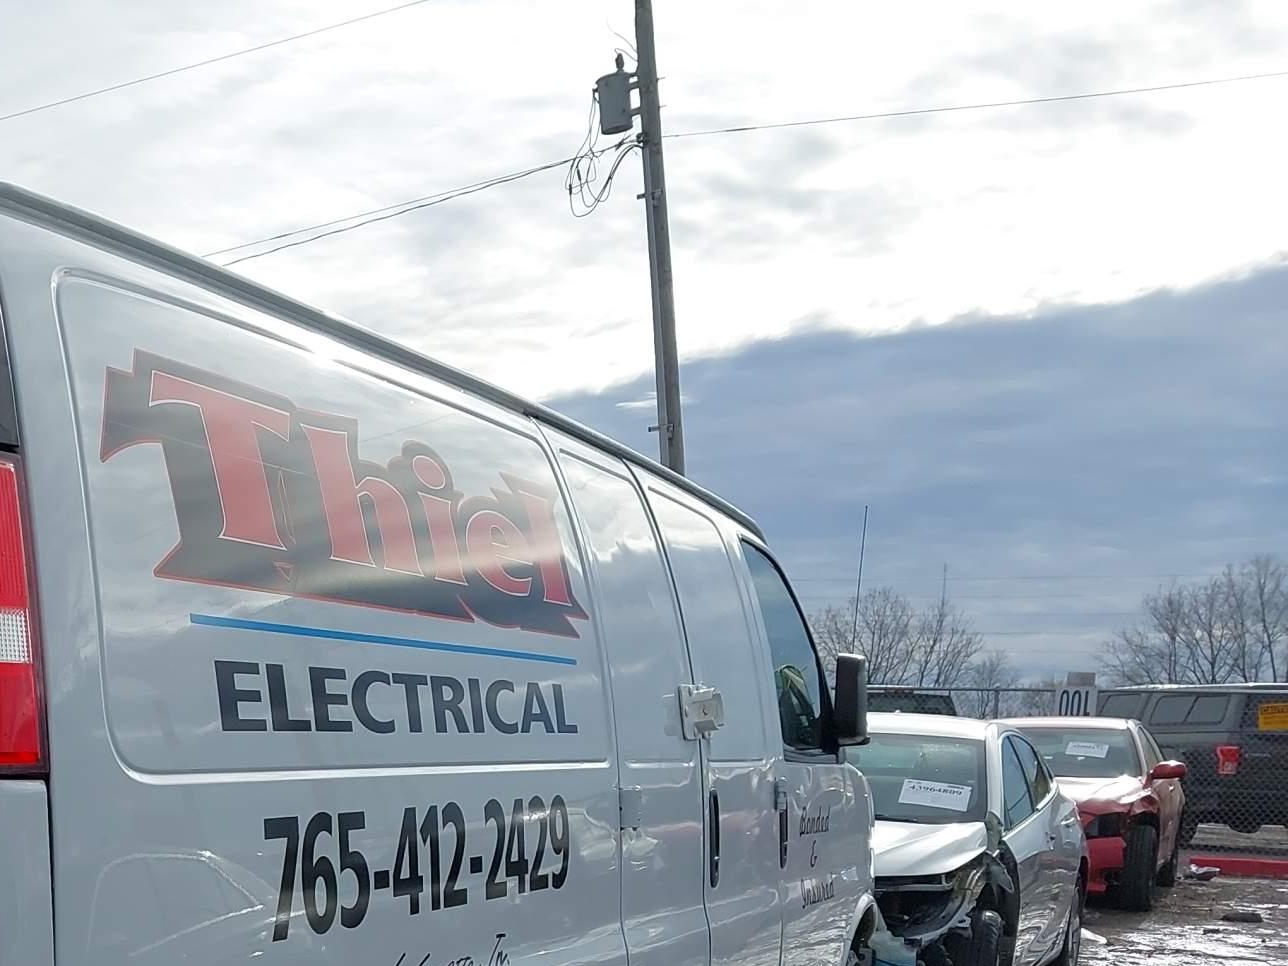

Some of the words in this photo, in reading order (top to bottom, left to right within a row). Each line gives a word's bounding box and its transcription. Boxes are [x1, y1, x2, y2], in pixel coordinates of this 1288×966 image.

[148, 369, 573, 607] Thiel
[213, 659, 579, 735] ELECTRICAL
[263, 794, 571, 943] 765-412-2429
